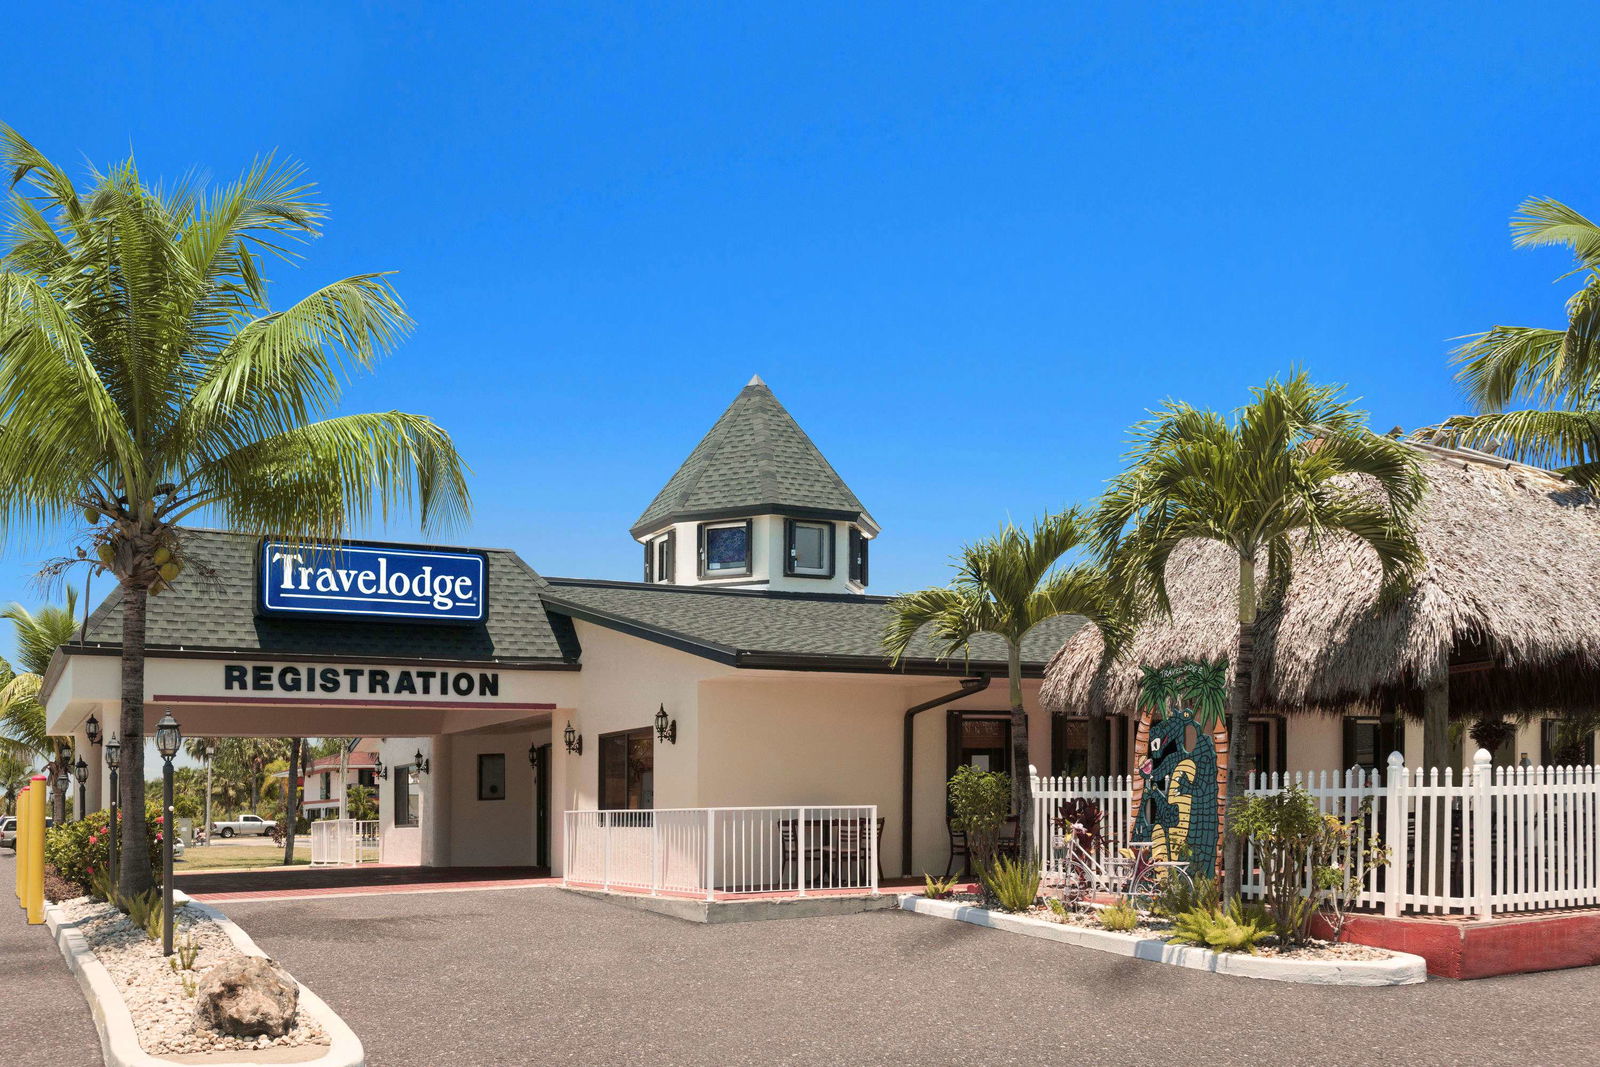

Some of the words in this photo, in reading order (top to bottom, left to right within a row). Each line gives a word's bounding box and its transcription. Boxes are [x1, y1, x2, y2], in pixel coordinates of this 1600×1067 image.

[272, 552, 473, 610] Travelodge
[224, 665, 499, 696] REGISTRATION
[1159, 664, 1204, 677] TRAVELODGE
